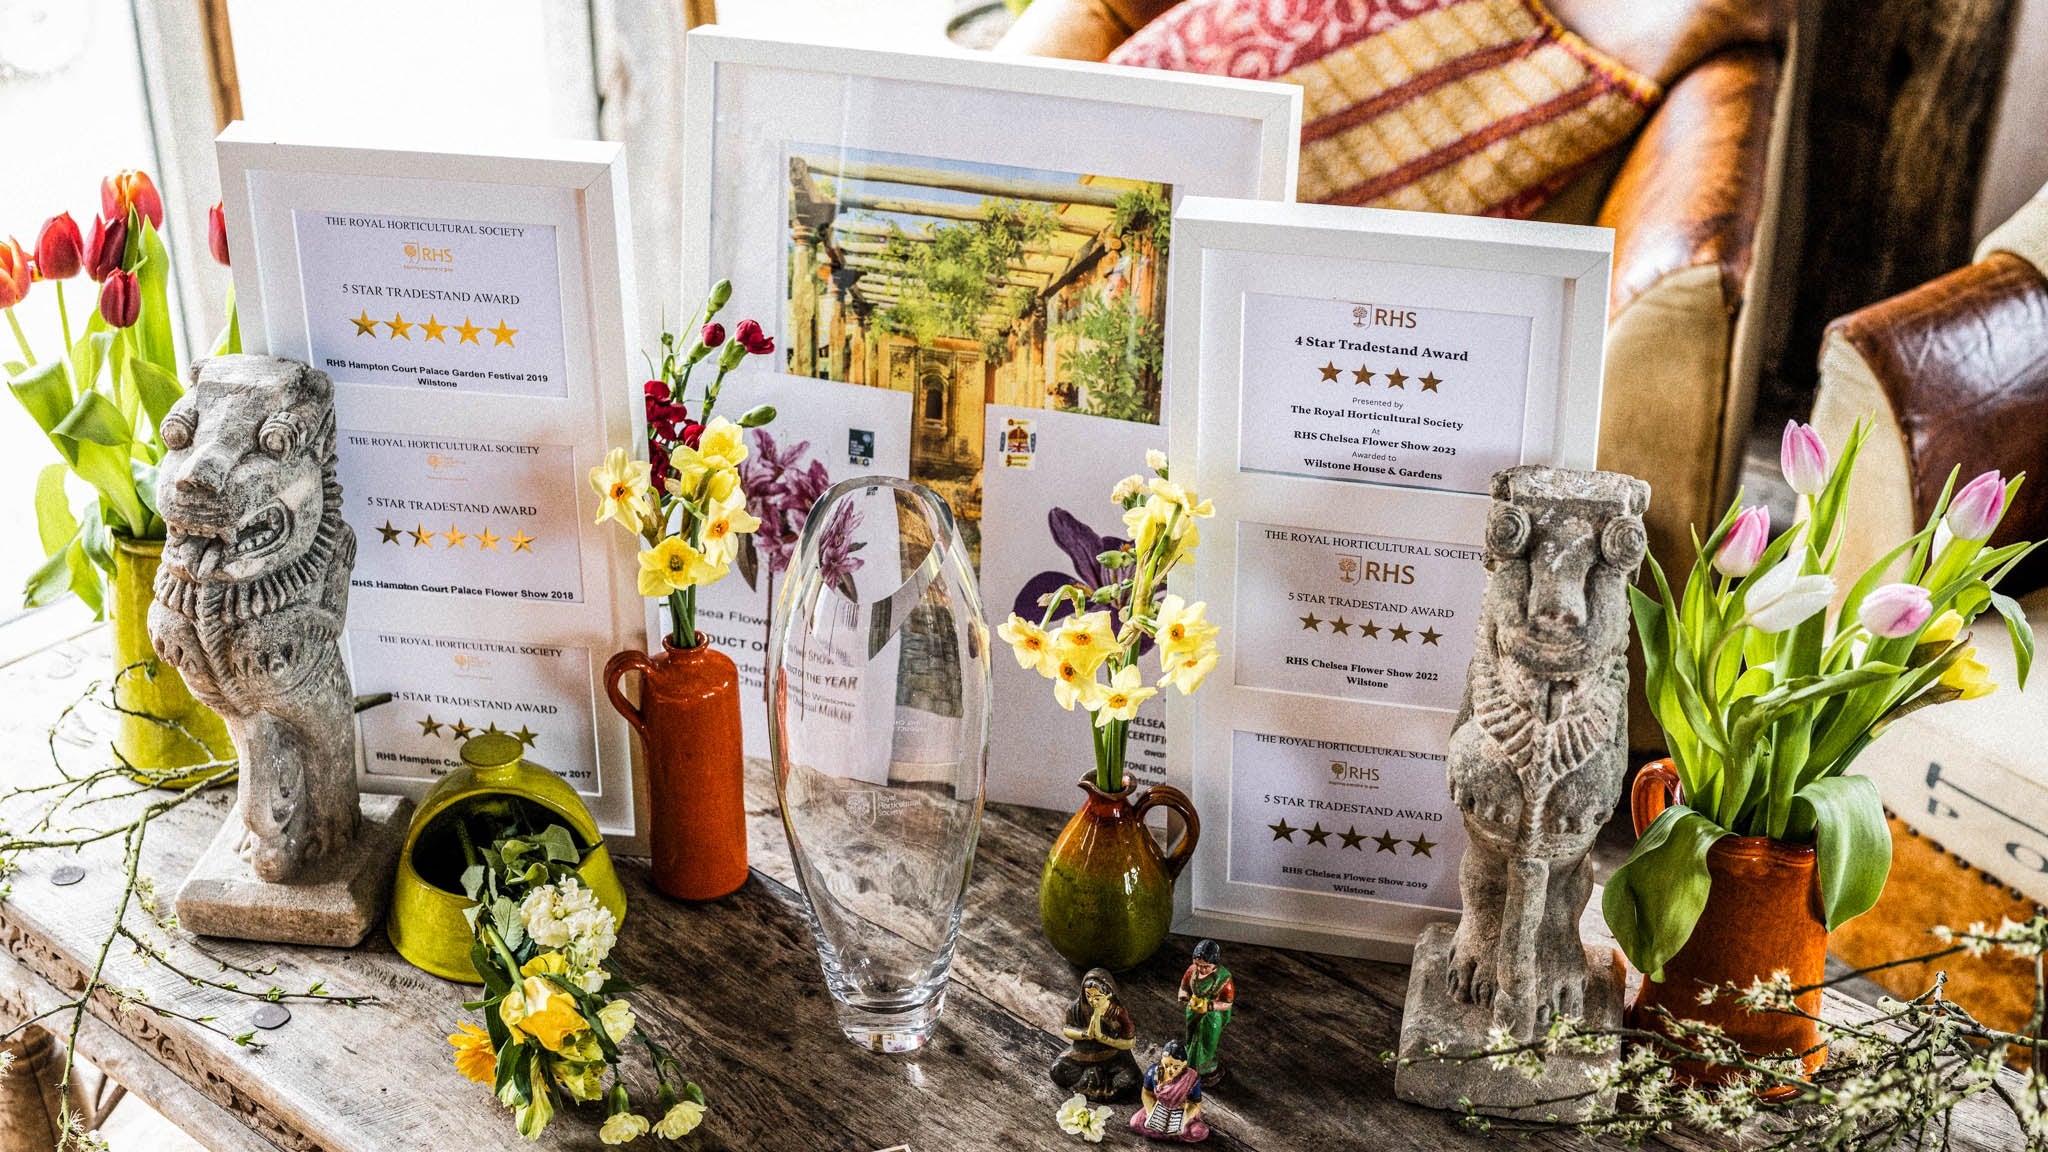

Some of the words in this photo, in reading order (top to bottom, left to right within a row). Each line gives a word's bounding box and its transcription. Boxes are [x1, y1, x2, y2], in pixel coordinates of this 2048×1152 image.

[325, 216, 347, 227] THE
[349, 217, 385, 229] ROYAL
[387, 219, 477, 235] HORTICULTURAL
[479, 226, 524, 238] SOCIETY
[422, 247, 453, 263] RHS
[342, 283, 349, 294] 5
[351, 284, 383, 297] STAR
[386, 287, 471, 302] TRADESTAND
[473, 292, 520, 305] AWARD
[1374, 308, 1417, 329] RHS
[1294, 336, 1303, 346] 4
[1306, 336, 1335, 349] Star
[1338, 338, 1418, 358] Tradestand
[1422, 347, 1468, 362] Award
[326, 358, 347, 369] RHS
[348, 360, 390, 374] Hampton
[391, 364, 417, 375] Court
[419, 366, 450, 377] Palace
[452, 368, 486, 379] Garden
[488, 371, 524, 382] Festival
[526, 373, 548, 383] 2019
[417, 377, 458, 388] Wilstone
[1352, 397, 1392, 408] Presented
[1394, 401, 1404, 410] by
[1290, 405, 1311, 416] The
[1313, 406, 1345, 419] Royal
[1347, 409, 1421, 426] Horticultural
[1423, 417, 1464, 431] Society
[348, 436, 370, 446] THE
[371, 437, 406, 448] ROYAL
[408, 439, 494, 453] HORTICULTURAL
[495, 443, 540, 455] SOCIETY
[1293, 430, 1317, 441] RHS
[1319, 432, 1360, 445] Chelsea
[1362, 436, 1399, 449] Flower
[1401, 440, 1431, 452] Show
[1432, 445, 1457, 456] 2023
[1352, 451, 1386, 461] Awarded
[1304, 457, 1351, 472] Wilstone
[1353, 463, 1386, 475] House
[1387, 466, 1396, 476] &
[1399, 467, 1443, 481] Gardens
[367, 497, 374, 506] 5
[376, 497, 406, 509] STAR
[408, 500, 490, 514] TRADESTAND
[492, 505, 537, 516] AWARD
[1264, 529, 1288, 541] THE
[1290, 532, 1330, 546] ROYAL
[1332, 537, 1432, 556] HORTICULTURAL
[1434, 547, 1487, 561] SOCIETY
[1365, 560, 1416, 585] RHS
[351, 579, 374, 588] RHS
[376, 580, 420, 593] Hampton
[421, 584, 449, 594] Court
[450, 585, 483, 596] Palace
[485, 588, 519, 599] Flower
[521, 589, 548, 599] Show
[551, 591, 574, 600] 2018
[1288, 591, 1295, 601] 5
[1297, 592, 1326, 605] STAR
[1328, 595, 1408, 614] TRADESTAND
[1410, 606, 1455, 619] AWARD
[378, 633, 398, 643] THE
[400, 636, 434, 647] ROYAL
[435, 638, 519, 654] HORTICULTURAL
[520, 646, 563, 658] SOCIETY
[1286, 656, 1309, 666] RHS
[1311, 658, 1349, 671] Chelsea
[1351, 663, 1385, 676] Flower
[1386, 667, 1414, 679] Show
[1415, 671, 1439, 681] 2022
[824, 675, 858, 691] YEAR
[1347, 676, 1389, 689] Wilstone
[393, 691, 400, 700] 4
[402, 691, 432, 703] STAR
[435, 694, 512, 711] TRADESTAND
[514, 702, 558, 715] AWARD
[1127, 730, 1166, 745] CERTIFI
[1255, 733, 1276, 744] THE
[1278, 735, 1316, 749] ROYAL
[1317, 740, 1407, 759] HORTICULTURAL
[376, 752, 397, 761] RHS
[399, 754, 442, 766] Hampton
[569, 770, 591, 779] 2017
[1349, 766, 1380, 781] RHS
[1264, 794, 1270, 804] 5
[1273, 794, 1305, 807] STAR
[1307, 799, 1394, 818] TRADESTAND
[1395, 809, 1443, 822] AWARD
[1282, 865, 1303, 876] RHS
[1304, 868, 1342, 881] Chelsea
[1343, 873, 1377, 885] Flower
[1378, 876, 1405, 888] Show
[1405, 880, 1428, 890] 2019
[1332, 884, 1376, 896] Wilstone
